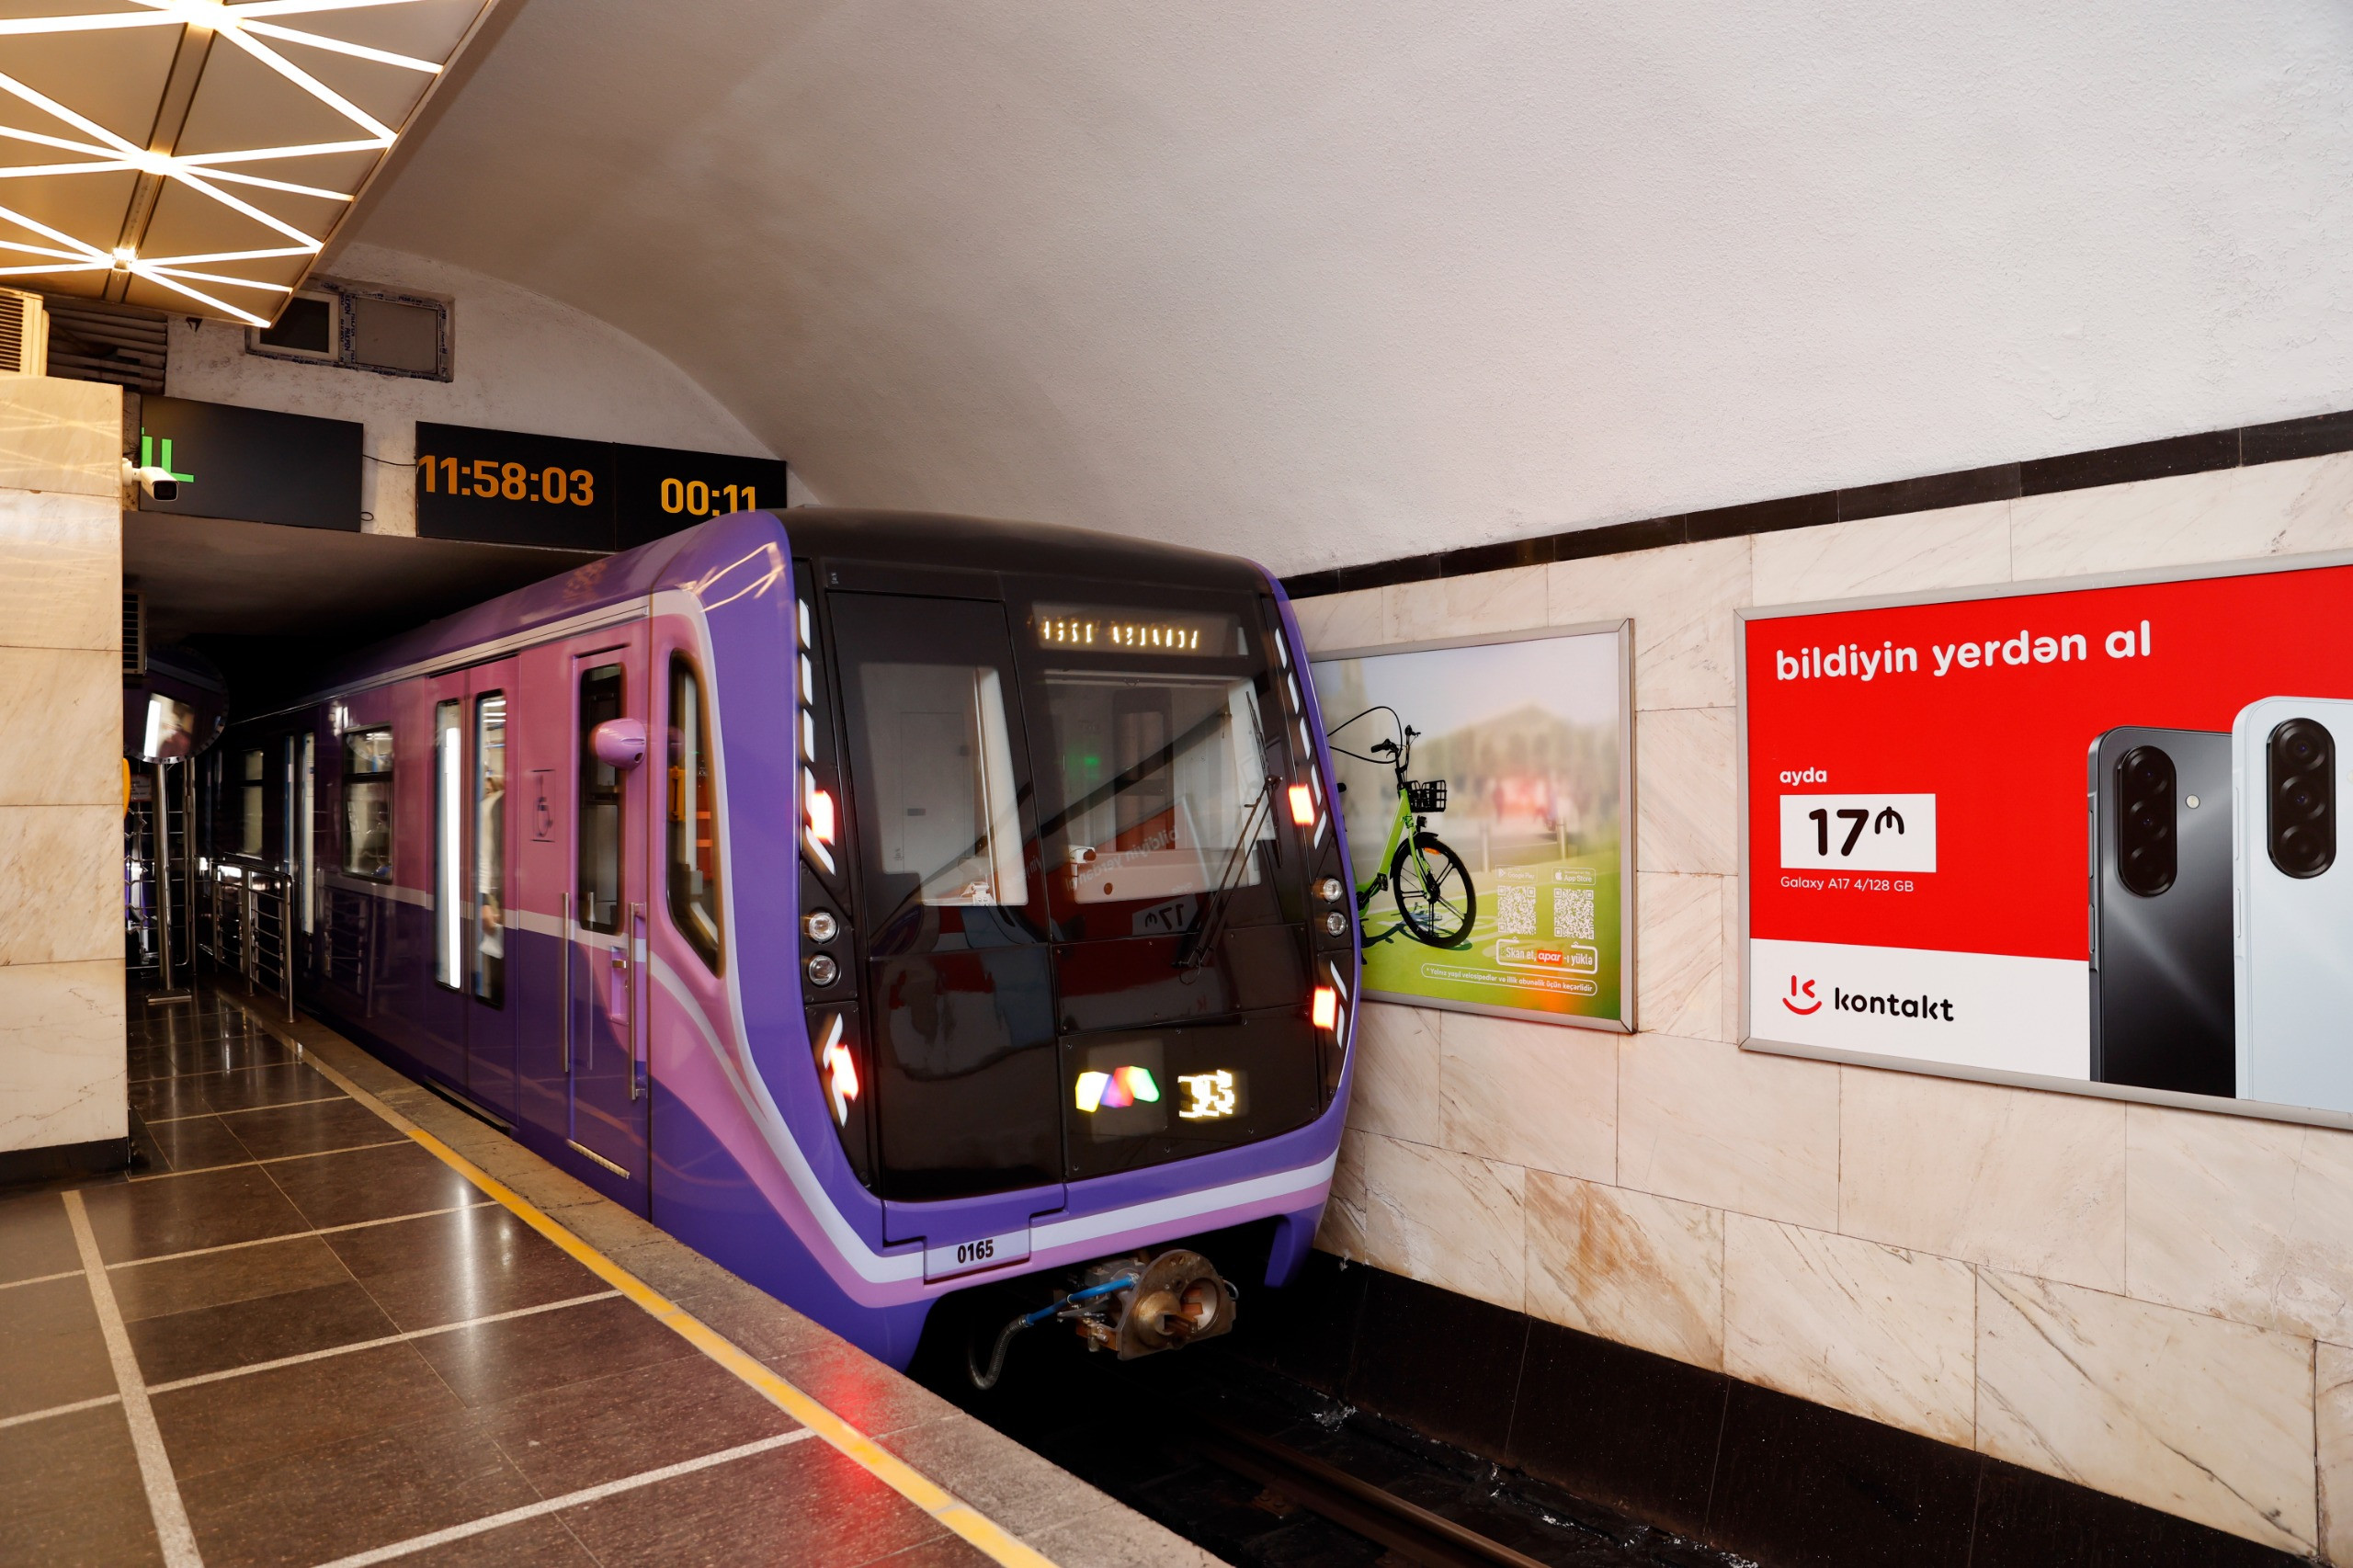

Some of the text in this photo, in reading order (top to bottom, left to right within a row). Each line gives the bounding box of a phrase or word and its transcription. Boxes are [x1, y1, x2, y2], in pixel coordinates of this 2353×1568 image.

[418, 455, 594, 506] 11:58:03
[661, 478, 756, 517] 00:11
[1776, 619, 2151, 682] bildiyin yerdən al
[1779, 767, 1827, 786] ayda
[1780, 876, 1914, 892] Galaxy A17 4/128 GB
[1506, 947, 1524, 959] Skan
[1526, 949, 1537, 962] et,
[1538, 952, 1561, 962] apar
[1571, 952, 1593, 966] yüklə
[1835, 987, 1954, 1021] kontakt
[957, 1239, 994, 1264] 0165
